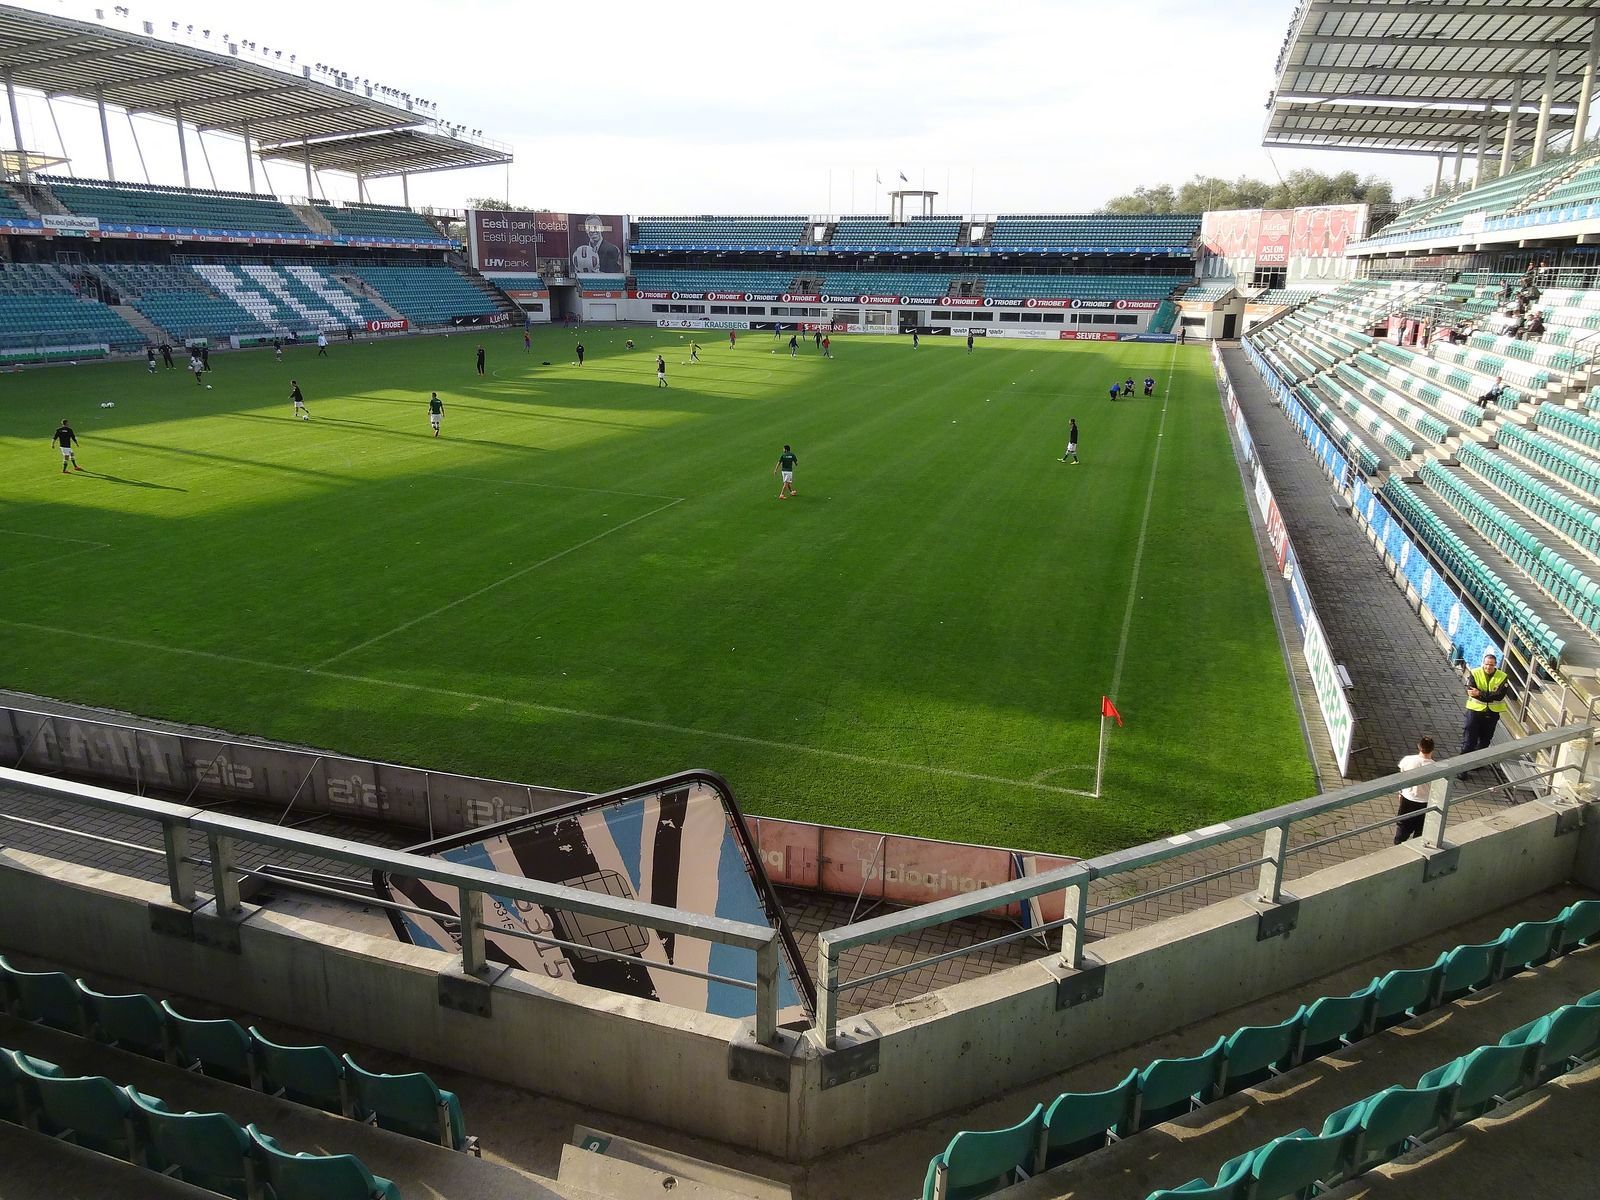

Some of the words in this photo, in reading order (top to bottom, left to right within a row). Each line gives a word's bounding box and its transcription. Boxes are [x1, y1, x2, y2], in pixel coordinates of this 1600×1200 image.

[482, 218, 509, 229] Eesti
[511, 220, 535, 231] pank
[538, 220, 568, 231] toetab
[483, 231, 507, 242] Eesti
[508, 232, 546, 245] jalgpalli.
[1261, 245, 1273, 254] ASI
[1274, 245, 1284, 253] ON
[1259, 253, 1285, 262] KAITSES
[1082, 300, 1112, 308] TRIOBET
[381, 320, 404, 329] TRIOBET
[704, 321, 748, 329] KRAUSBERG
[1076, 332, 1101, 340] SELVER
[1308, 621, 1348, 758] KRAUSBERG
